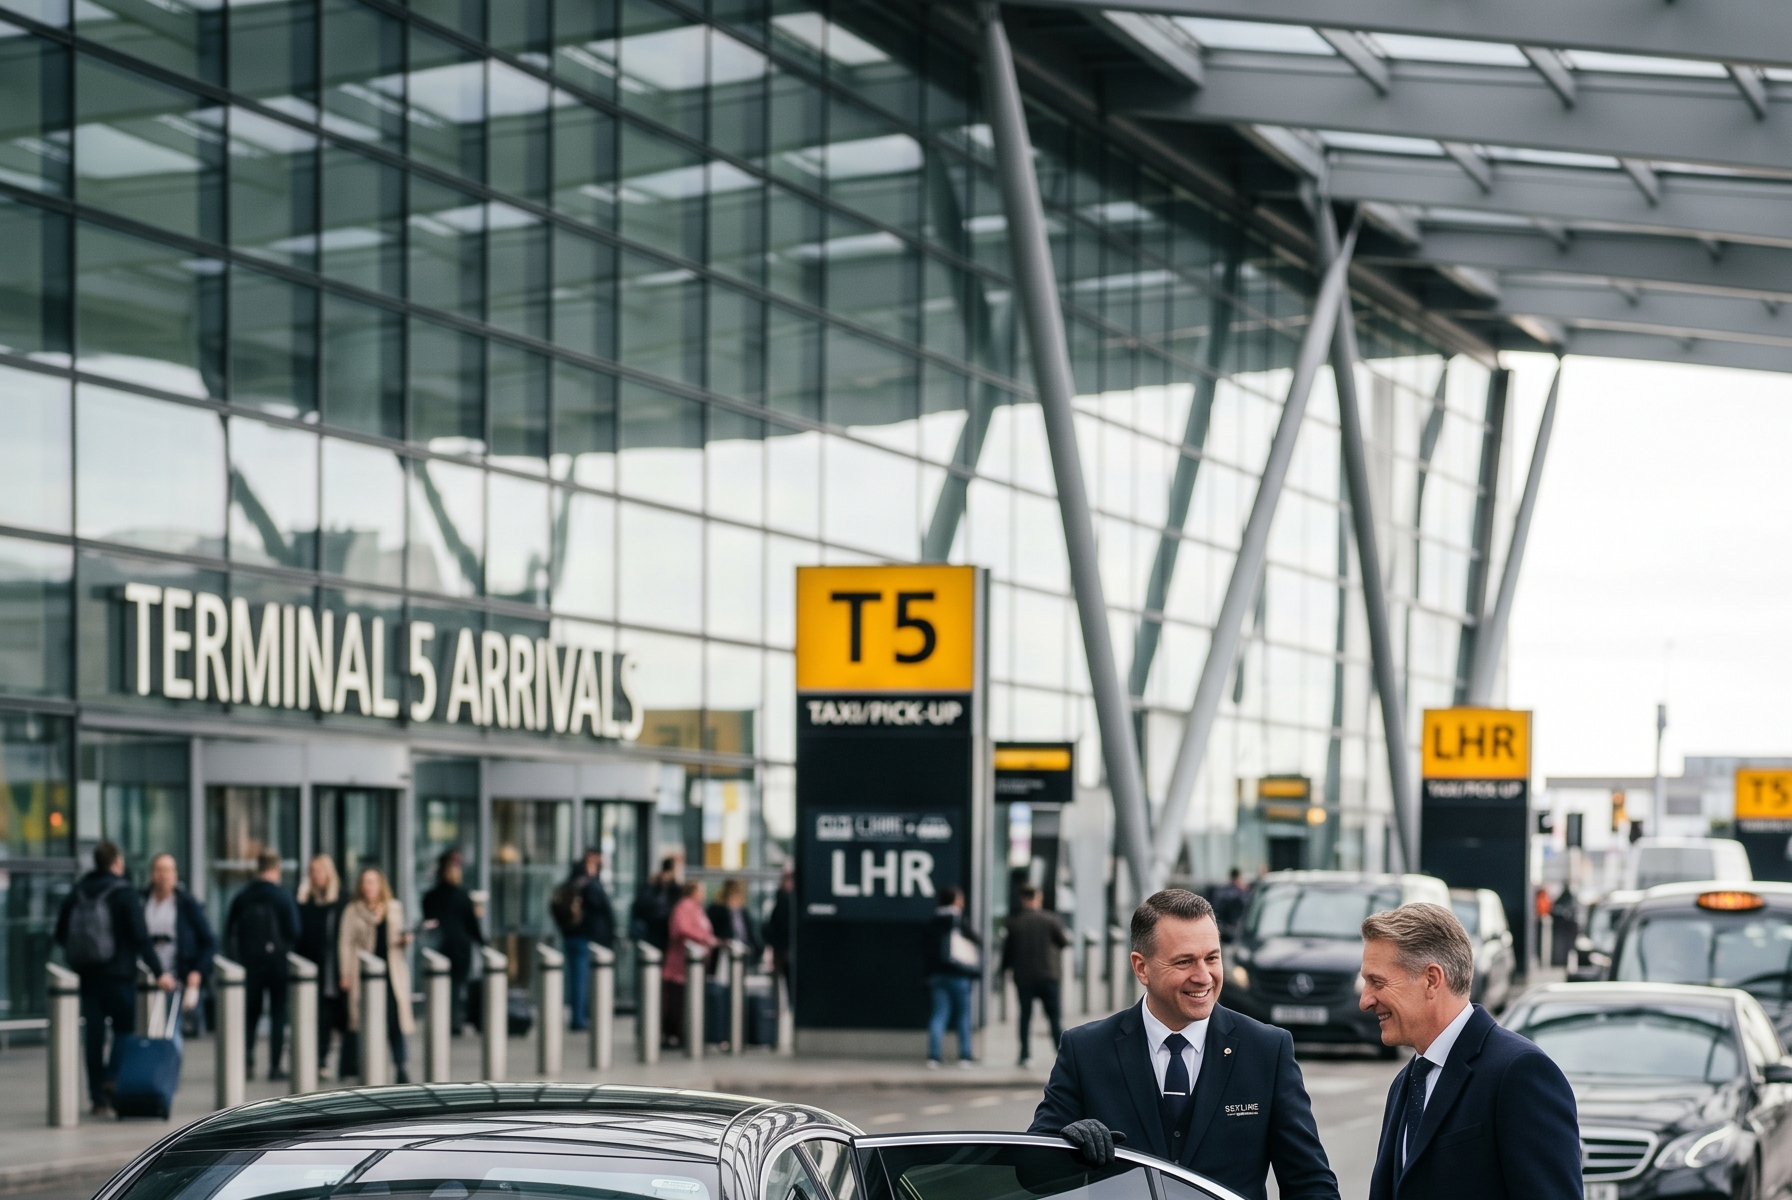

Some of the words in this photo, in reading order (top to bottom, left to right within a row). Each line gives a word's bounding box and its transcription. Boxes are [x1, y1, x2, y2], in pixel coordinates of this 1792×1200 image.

[831, 592, 936, 663] T5
[125, 582, 399, 719] TERMINAL
[410, 620, 437, 722] 5
[447, 627, 644, 740] ARRIVALS
[1434, 725, 1515, 759] LHR
[832, 850, 935, 898] LHR
